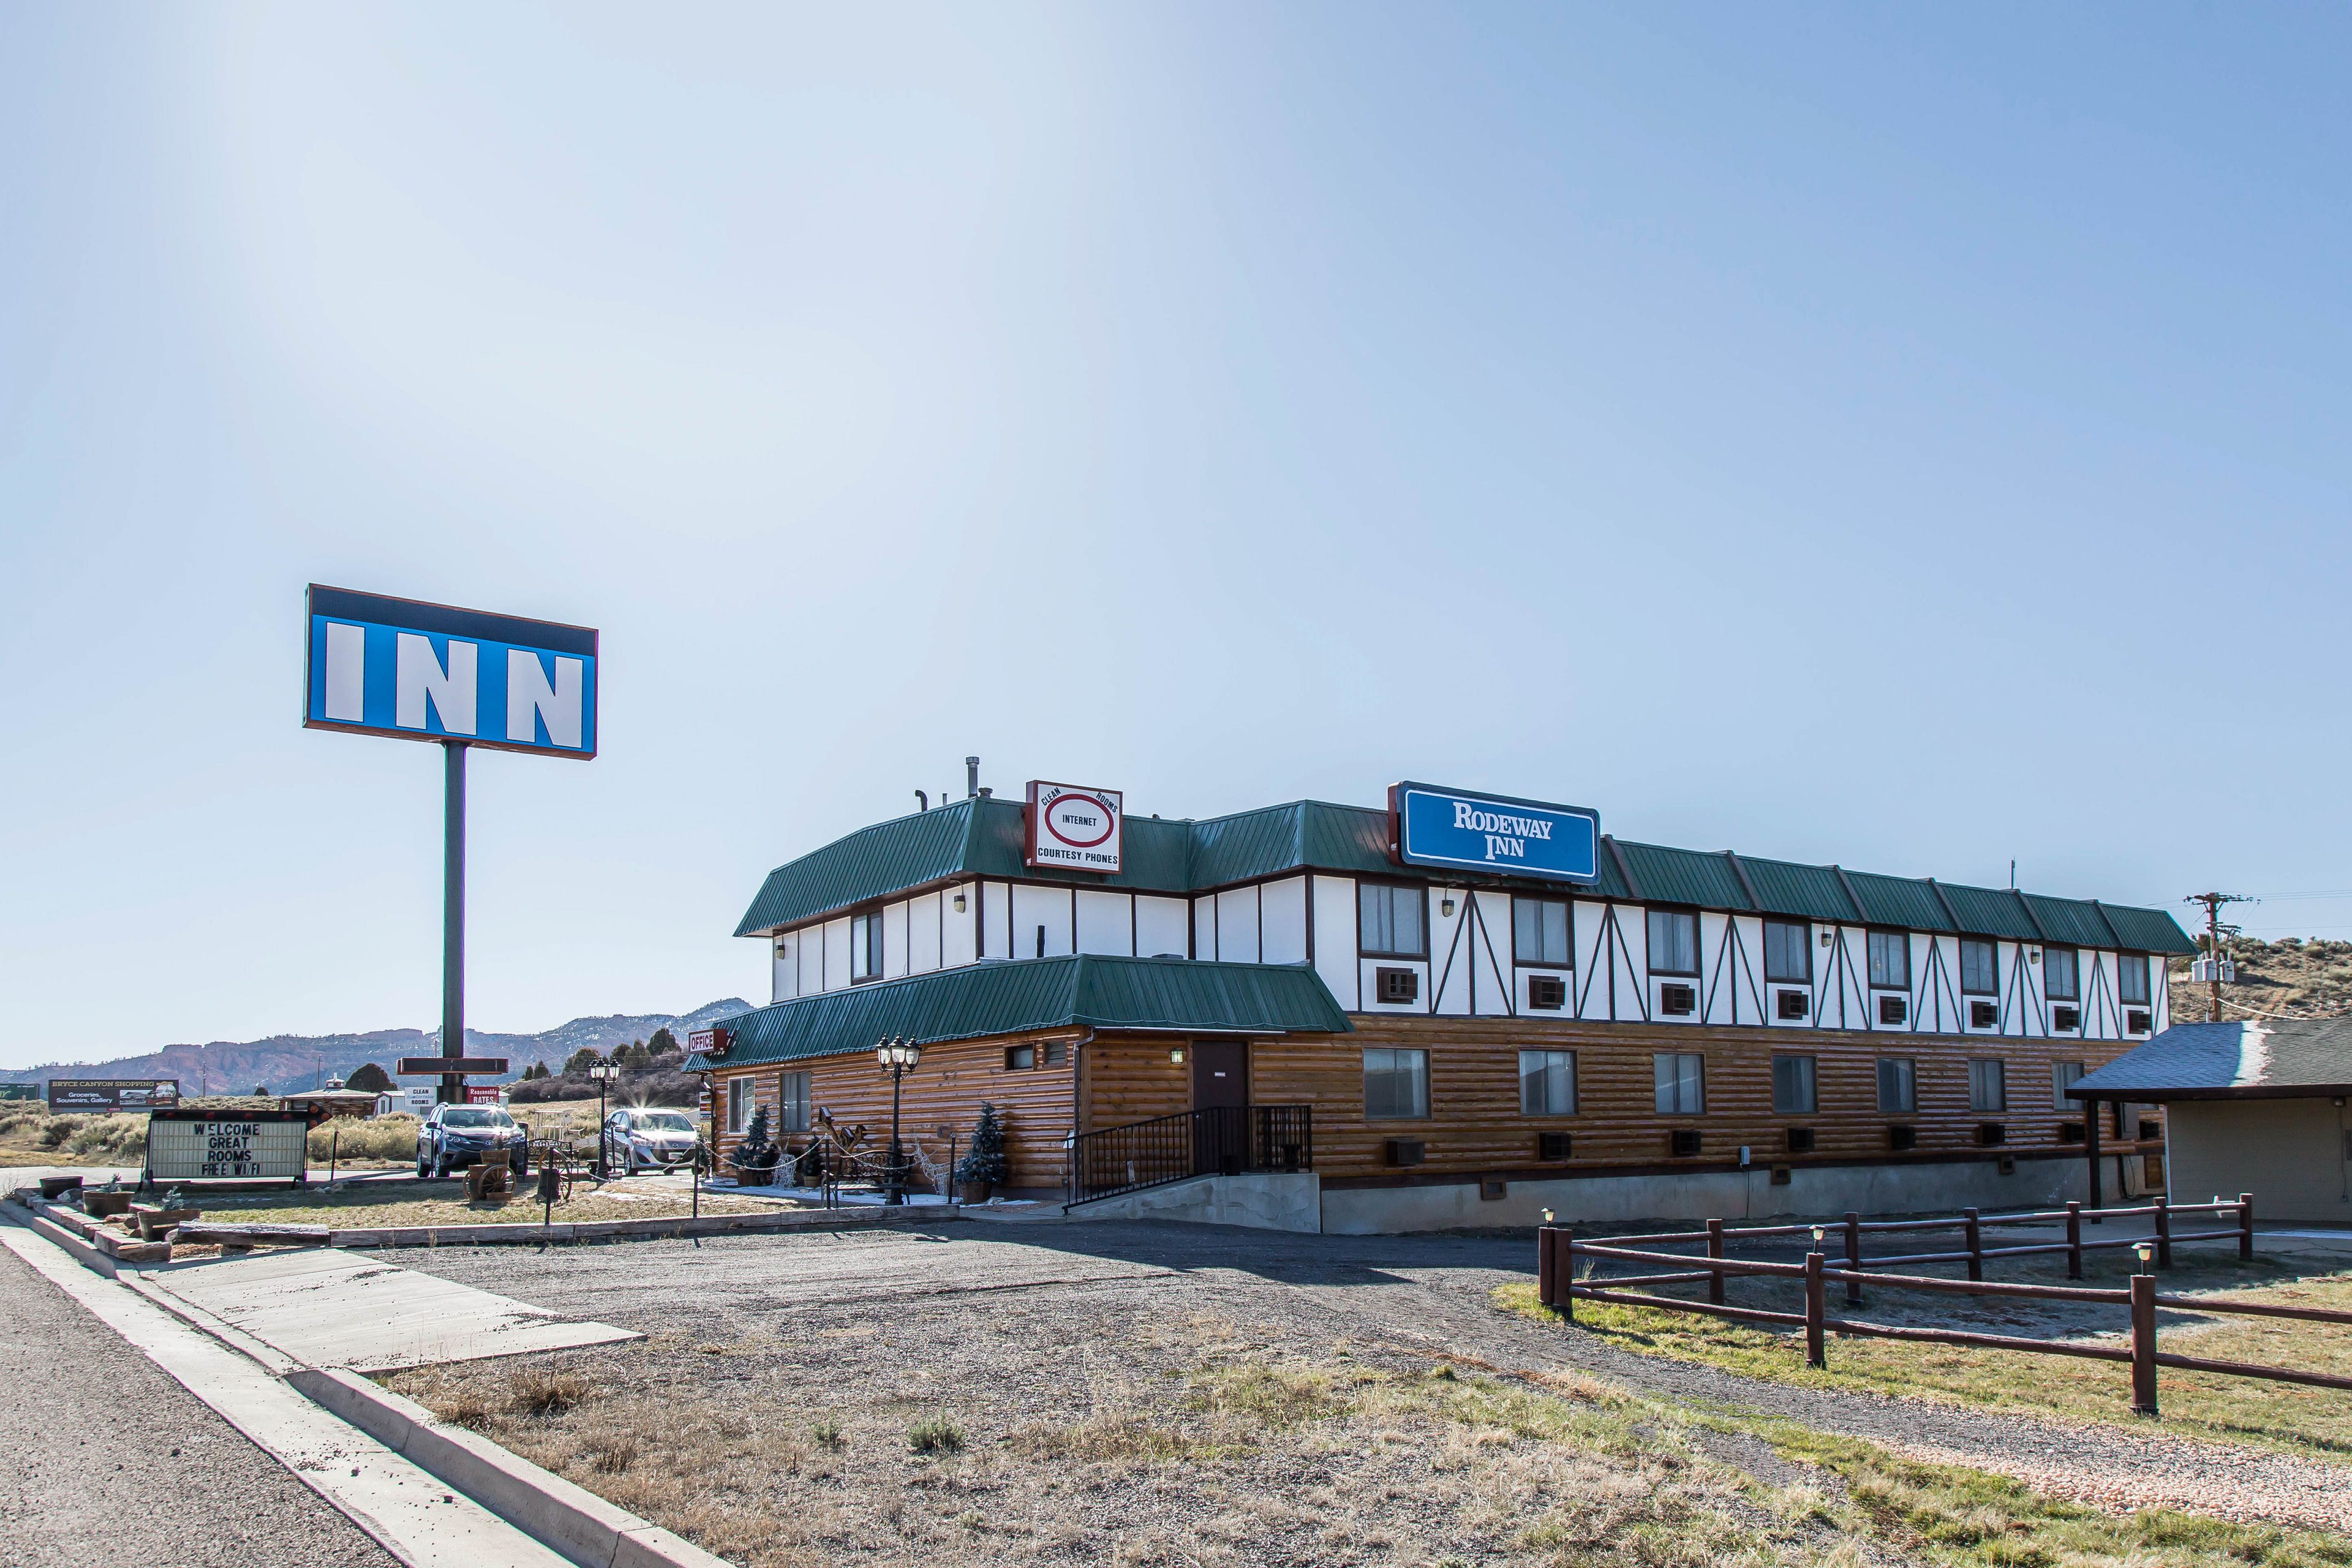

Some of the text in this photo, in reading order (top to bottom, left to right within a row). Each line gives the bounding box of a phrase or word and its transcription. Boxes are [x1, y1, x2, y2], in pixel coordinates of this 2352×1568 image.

[325, 622, 583, 749] INN
[1041, 787, 1118, 813] CLEAN ROOMS
[1062, 814, 1097, 827] INTERNET
[1452, 801, 1553, 840] RODEWAY
[1038, 847, 1118, 864] COURTESY PHONES
[1484, 835, 1525, 861] INN
[691, 1034, 713, 1050] OFFICE
[194, 1123, 260, 1136] WELCOME
[209, 1137, 249, 1148] GREAT
[208, 1150, 252, 1162] ROOMS
[202, 1163, 260, 1175] FREE WI/FI
